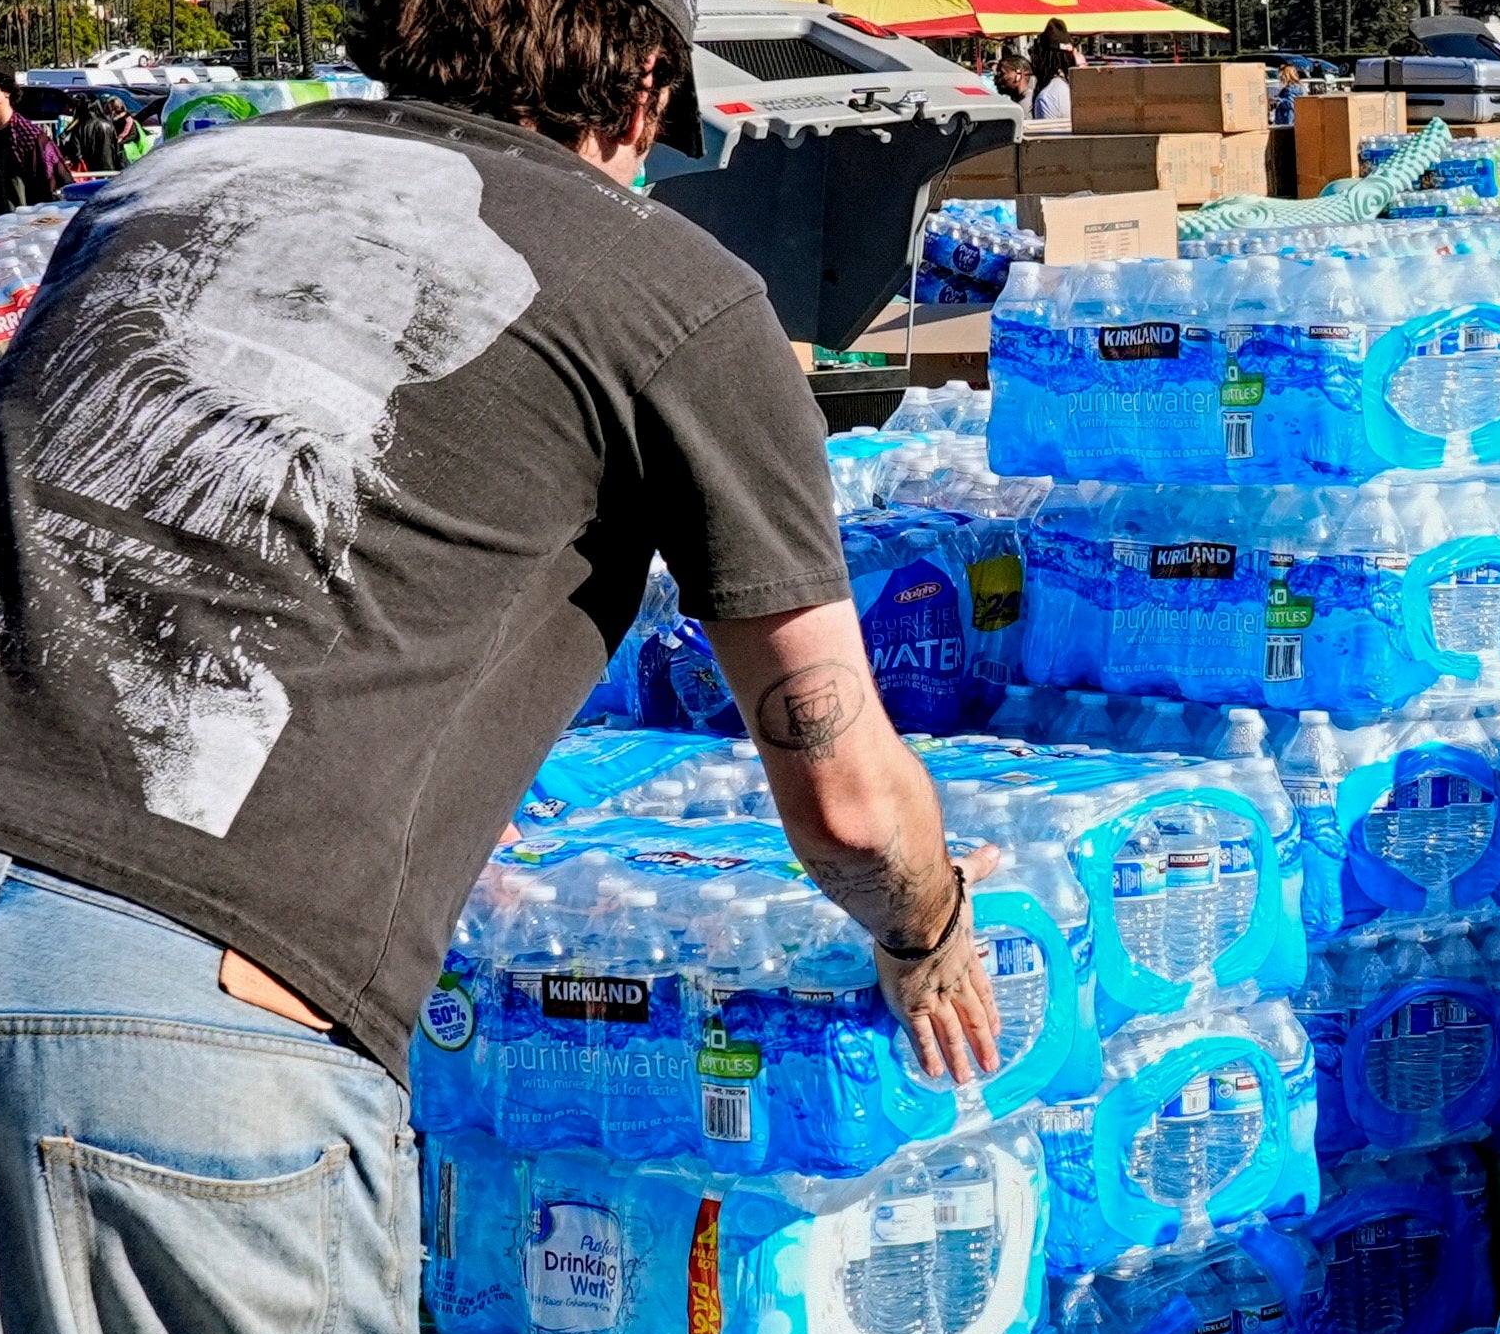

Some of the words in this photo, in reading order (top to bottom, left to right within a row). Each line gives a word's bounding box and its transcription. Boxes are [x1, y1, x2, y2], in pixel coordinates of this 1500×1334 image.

[1104, 327, 1174, 346] KIRKLAND
[1146, 391, 1213, 413] water
[899, 583, 938, 602] Ralphs
[1196, 612, 1261, 634] water
[1168, 853, 1209, 868] KIRKLAND
[548, 979, 642, 1005] KIRKLAND
[429, 1004, 467, 1027] 50%
[436, 1022, 466, 1036] RECYCLED
[441, 1030, 465, 1041] PLASTIC
[503, 1040, 599, 1075] purified
[603, 1049, 689, 1081] water
[523, 1075, 549, 1089] with
[622, 1084, 644, 1095] for
[647, 1084, 679, 1097] taste
